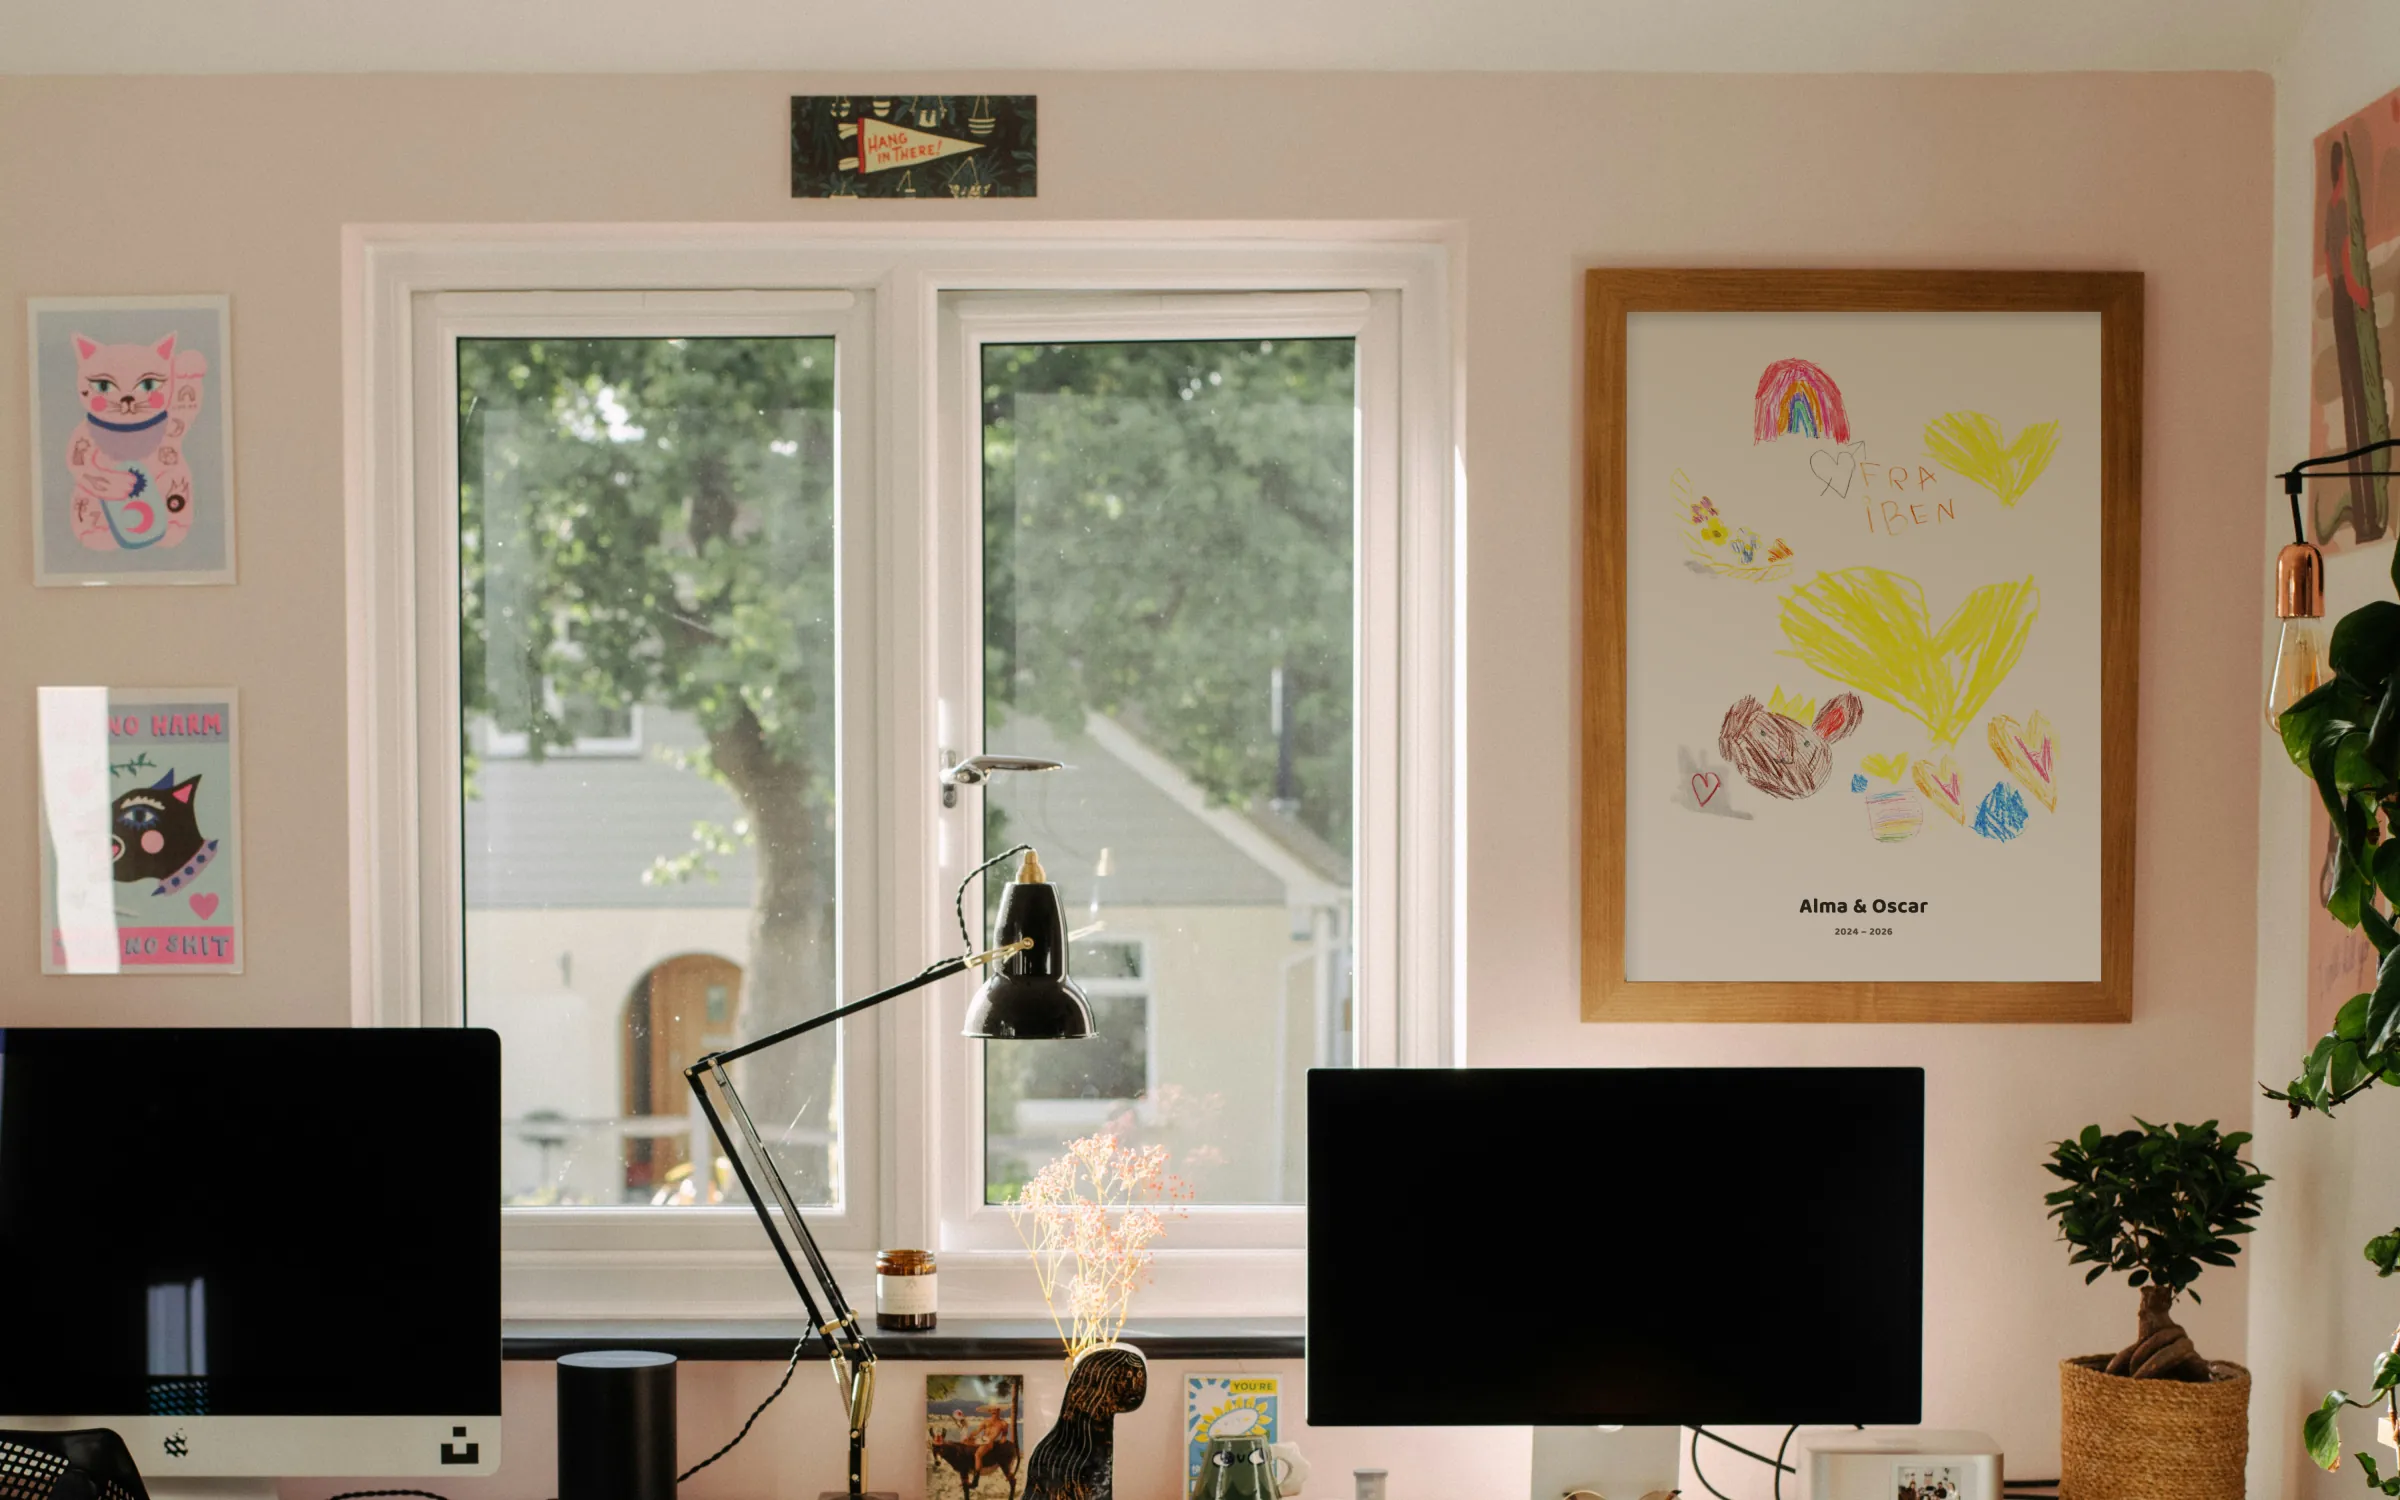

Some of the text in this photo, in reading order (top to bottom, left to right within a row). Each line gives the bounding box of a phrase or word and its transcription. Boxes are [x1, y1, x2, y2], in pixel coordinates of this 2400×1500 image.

[868, 132, 908, 155] HANG
[877, 139, 943, 164] IN THERE!
[1860, 462, 1937, 492] FRA
[108, 714, 140, 736] NO
[151, 712, 223, 737] HARM
[1799, 898, 1929, 914] Alma & Oscar
[1834, 927, 1859, 936] 2024
[1869, 927, 1893, 936] 2026
[125, 936, 158, 955] NO
[166, 934, 230, 957] SHIT
